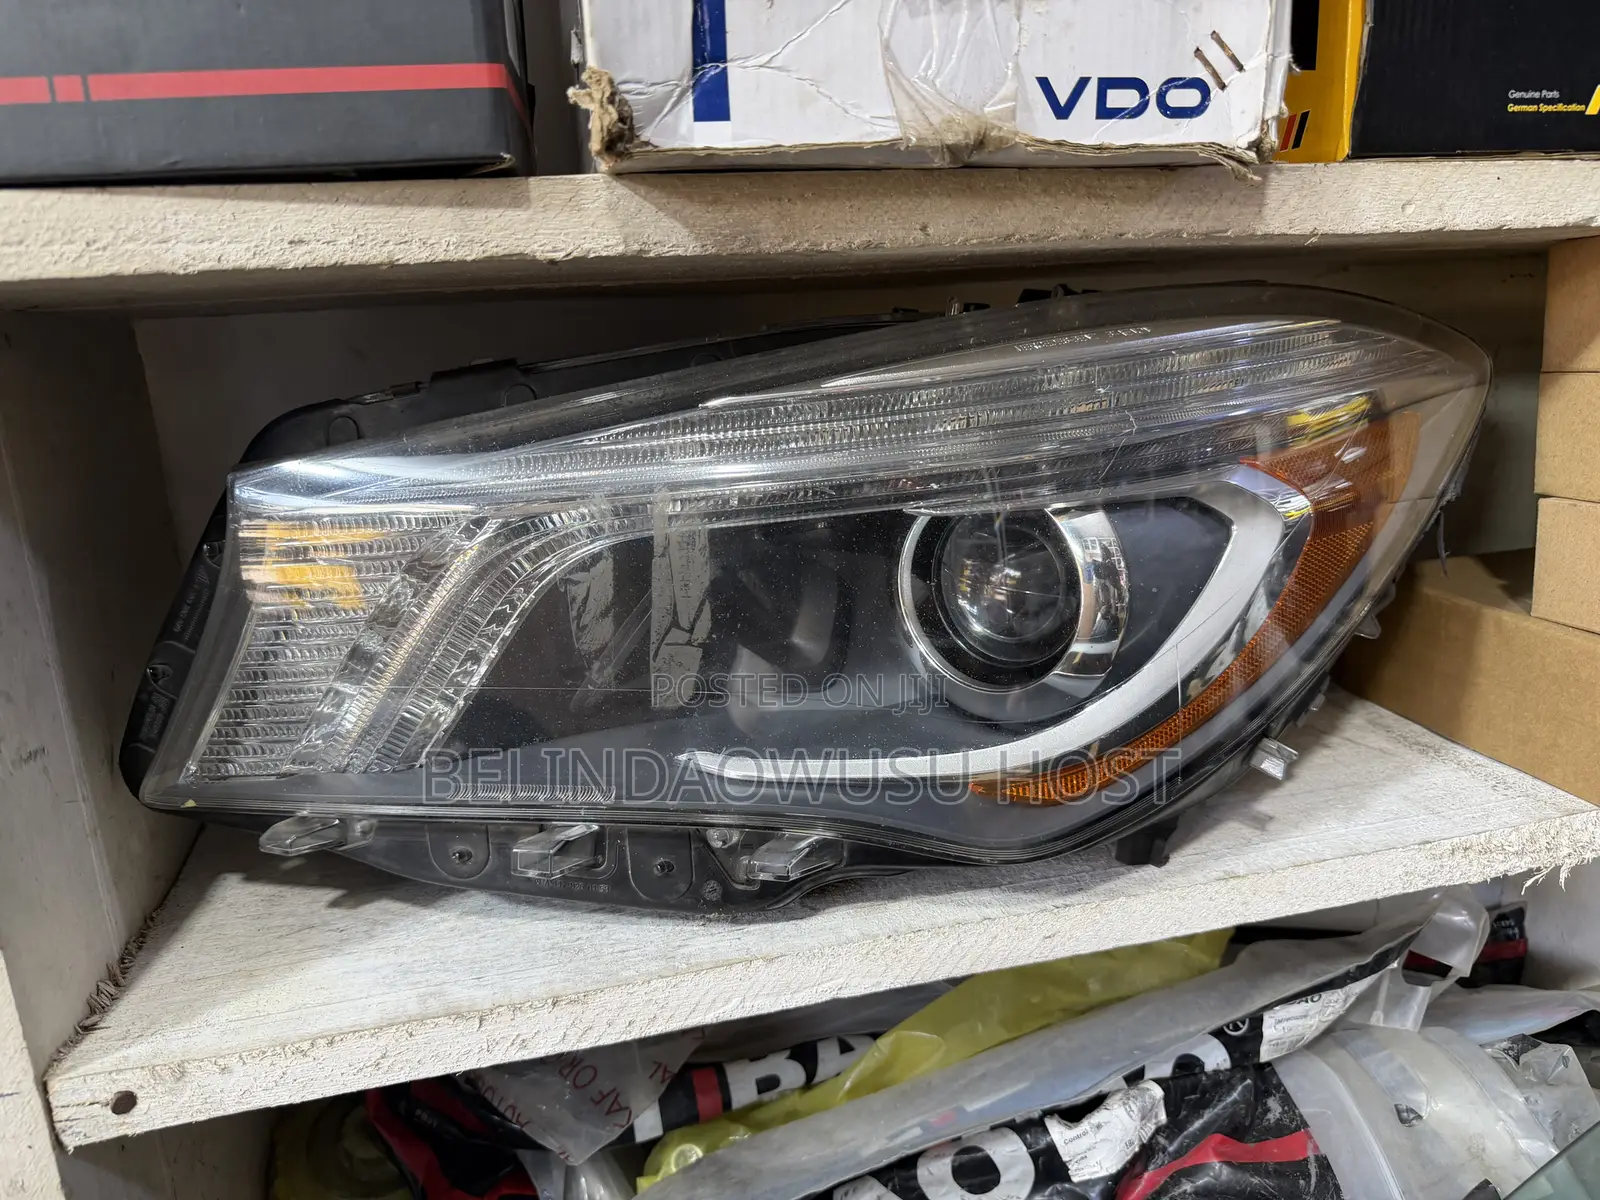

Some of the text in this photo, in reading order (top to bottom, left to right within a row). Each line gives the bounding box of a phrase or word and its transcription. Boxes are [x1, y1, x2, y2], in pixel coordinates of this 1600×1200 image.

[1035, 76, 1211, 120] VDO
[1508, 89, 1560, 99] Genuine Parts
[1507, 103, 1586, 113] German Specification
[1063, 1128, 1089, 1146] Control
